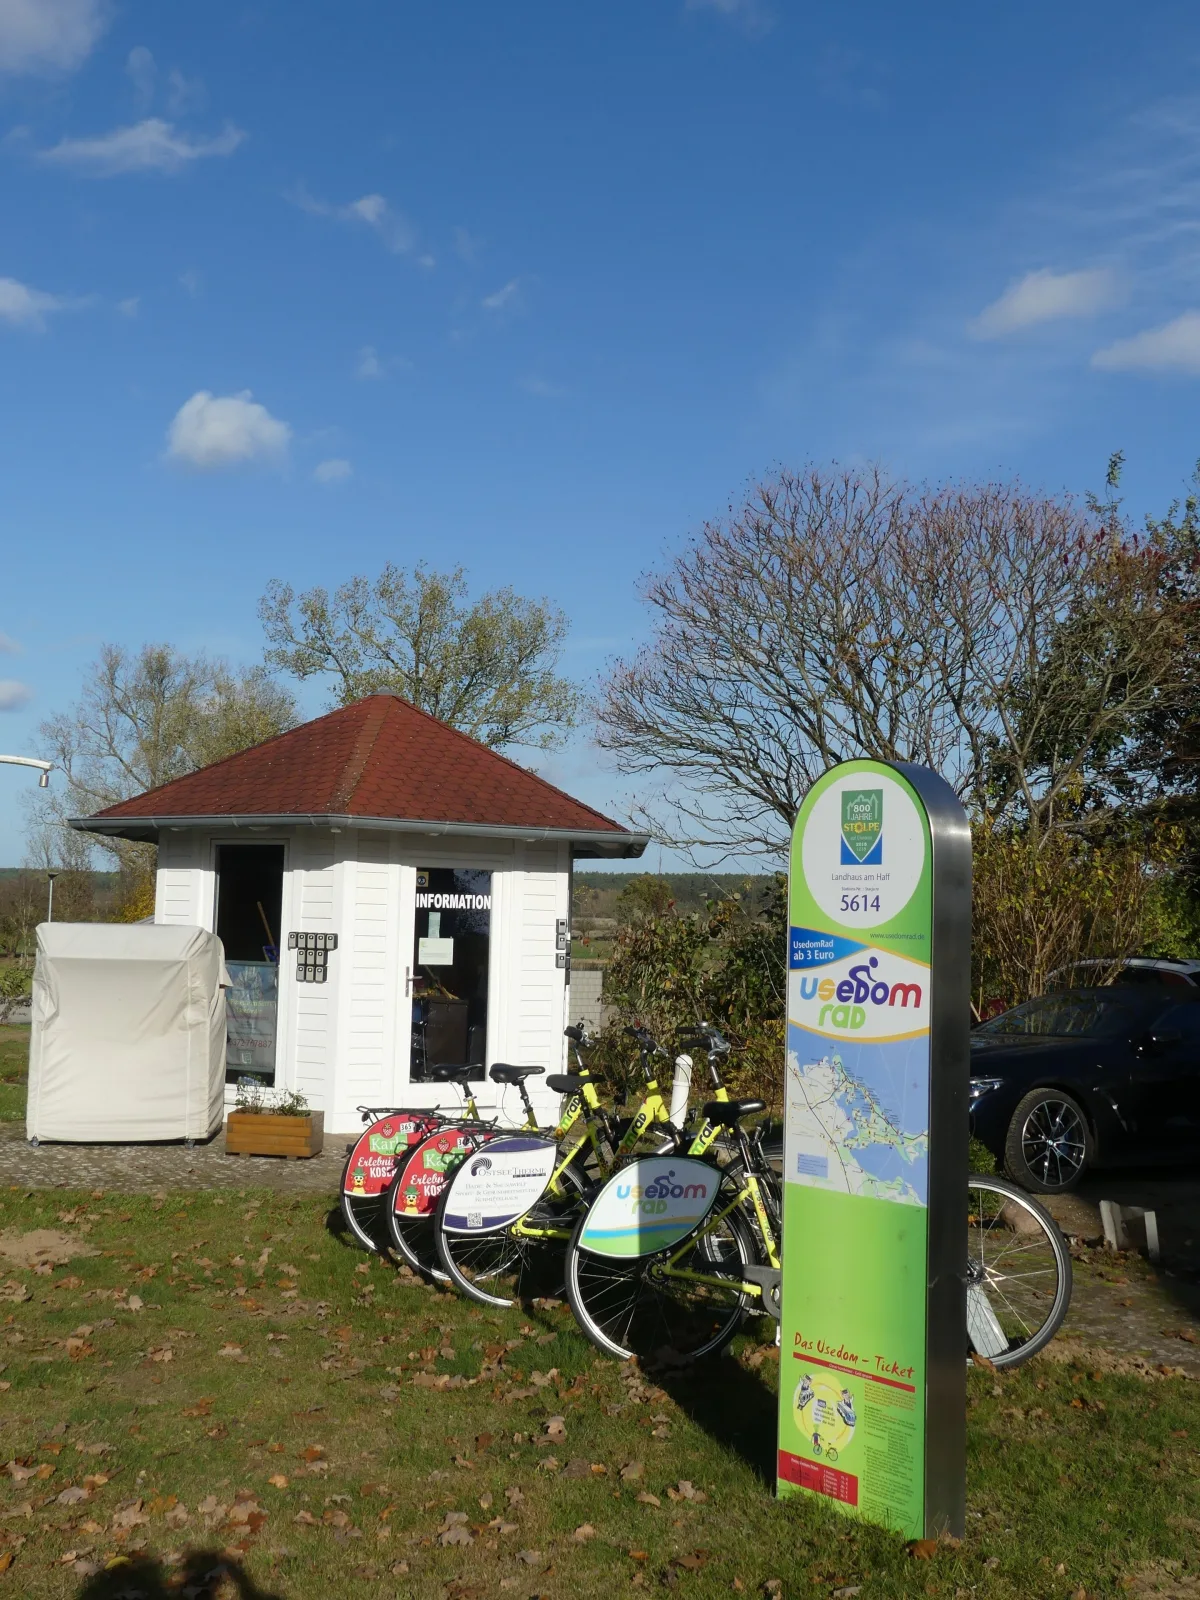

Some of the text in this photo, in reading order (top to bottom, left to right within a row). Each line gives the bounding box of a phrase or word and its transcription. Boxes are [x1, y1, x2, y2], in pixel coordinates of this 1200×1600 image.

[853, 804, 871, 813] 800
[850, 813, 873, 821] JAHRE
[831, 873, 862, 881] Landhaus
[876, 873, 891, 881] Haff
[416, 893, 492, 910] INFORMATION
[840, 894, 880, 912] 5614
[870, 932, 925, 940] www.usedomrad.de
[793, 939, 834, 949] UsedomRad
[793, 951, 834, 961] ab 3 Euro
[794, 1331, 813, 1350] Das
[816, 1338, 859, 1364] Usedom
[874, 1355, 915, 1379] Ticket
